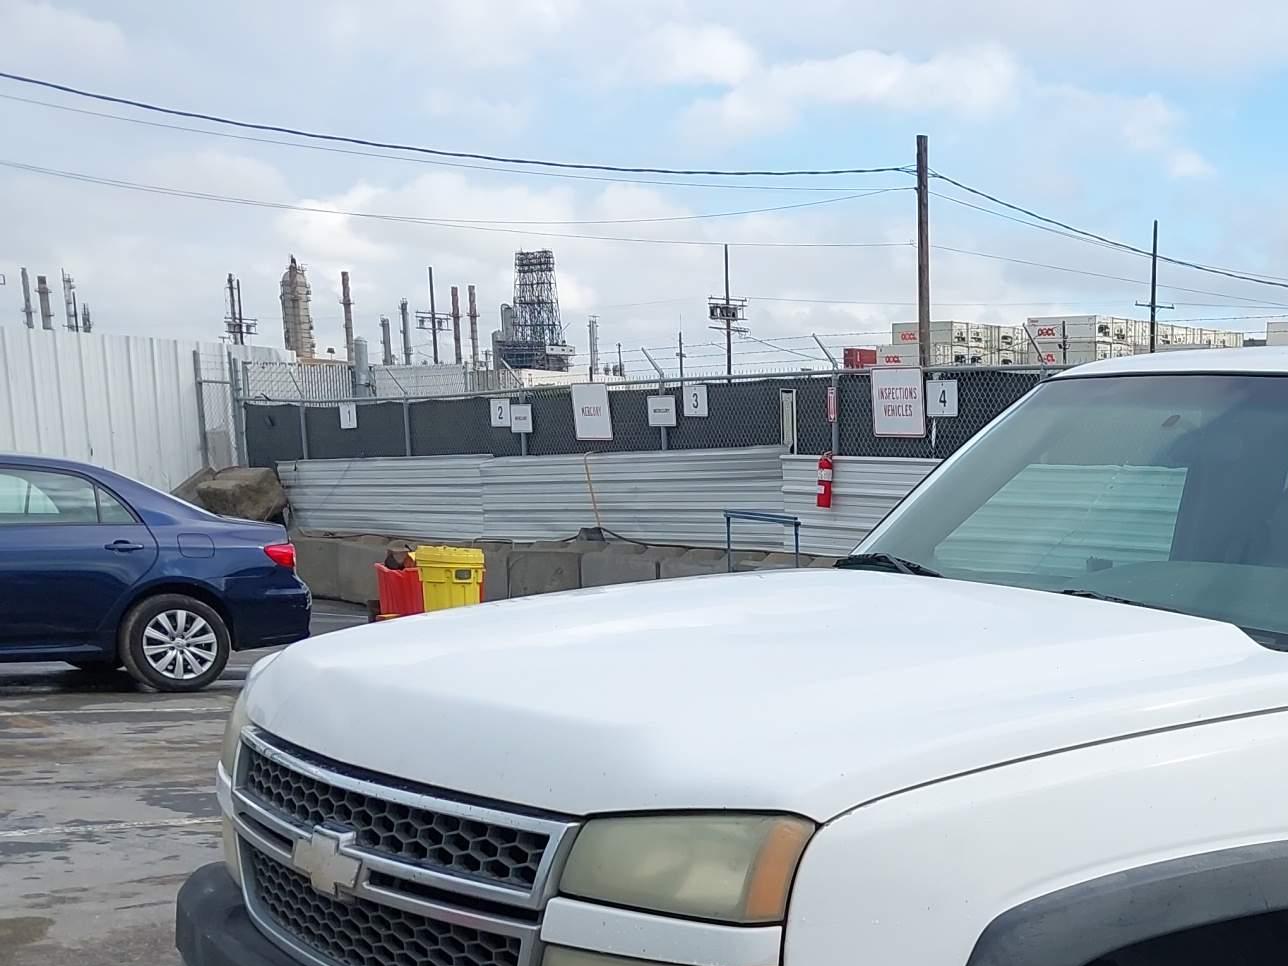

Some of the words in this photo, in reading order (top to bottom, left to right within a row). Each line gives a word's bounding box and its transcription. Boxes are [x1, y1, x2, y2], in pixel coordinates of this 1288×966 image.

[878, 387, 917, 399] INSPECTIONS
[939, 389, 947, 407] 4
[692, 393, 699, 409] 3
[498, 406, 503, 420] 2
[883, 404, 913, 416] VEHICLES
